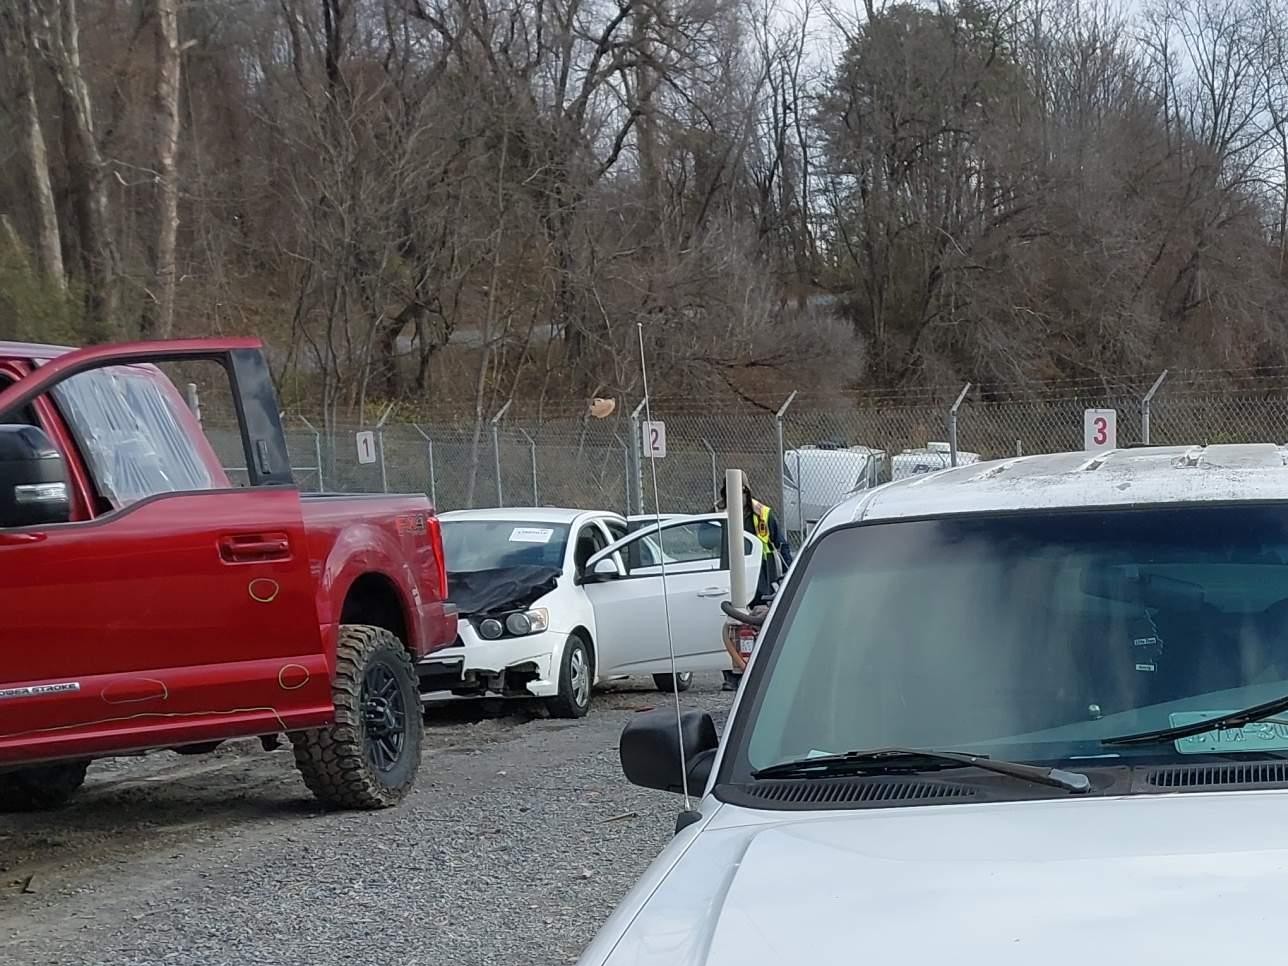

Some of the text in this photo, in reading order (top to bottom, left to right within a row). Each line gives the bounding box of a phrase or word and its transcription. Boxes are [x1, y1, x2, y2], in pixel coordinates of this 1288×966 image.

[651, 428, 659, 451] 2
[1093, 417, 1107, 445] 3
[362, 438, 370, 457] 1
